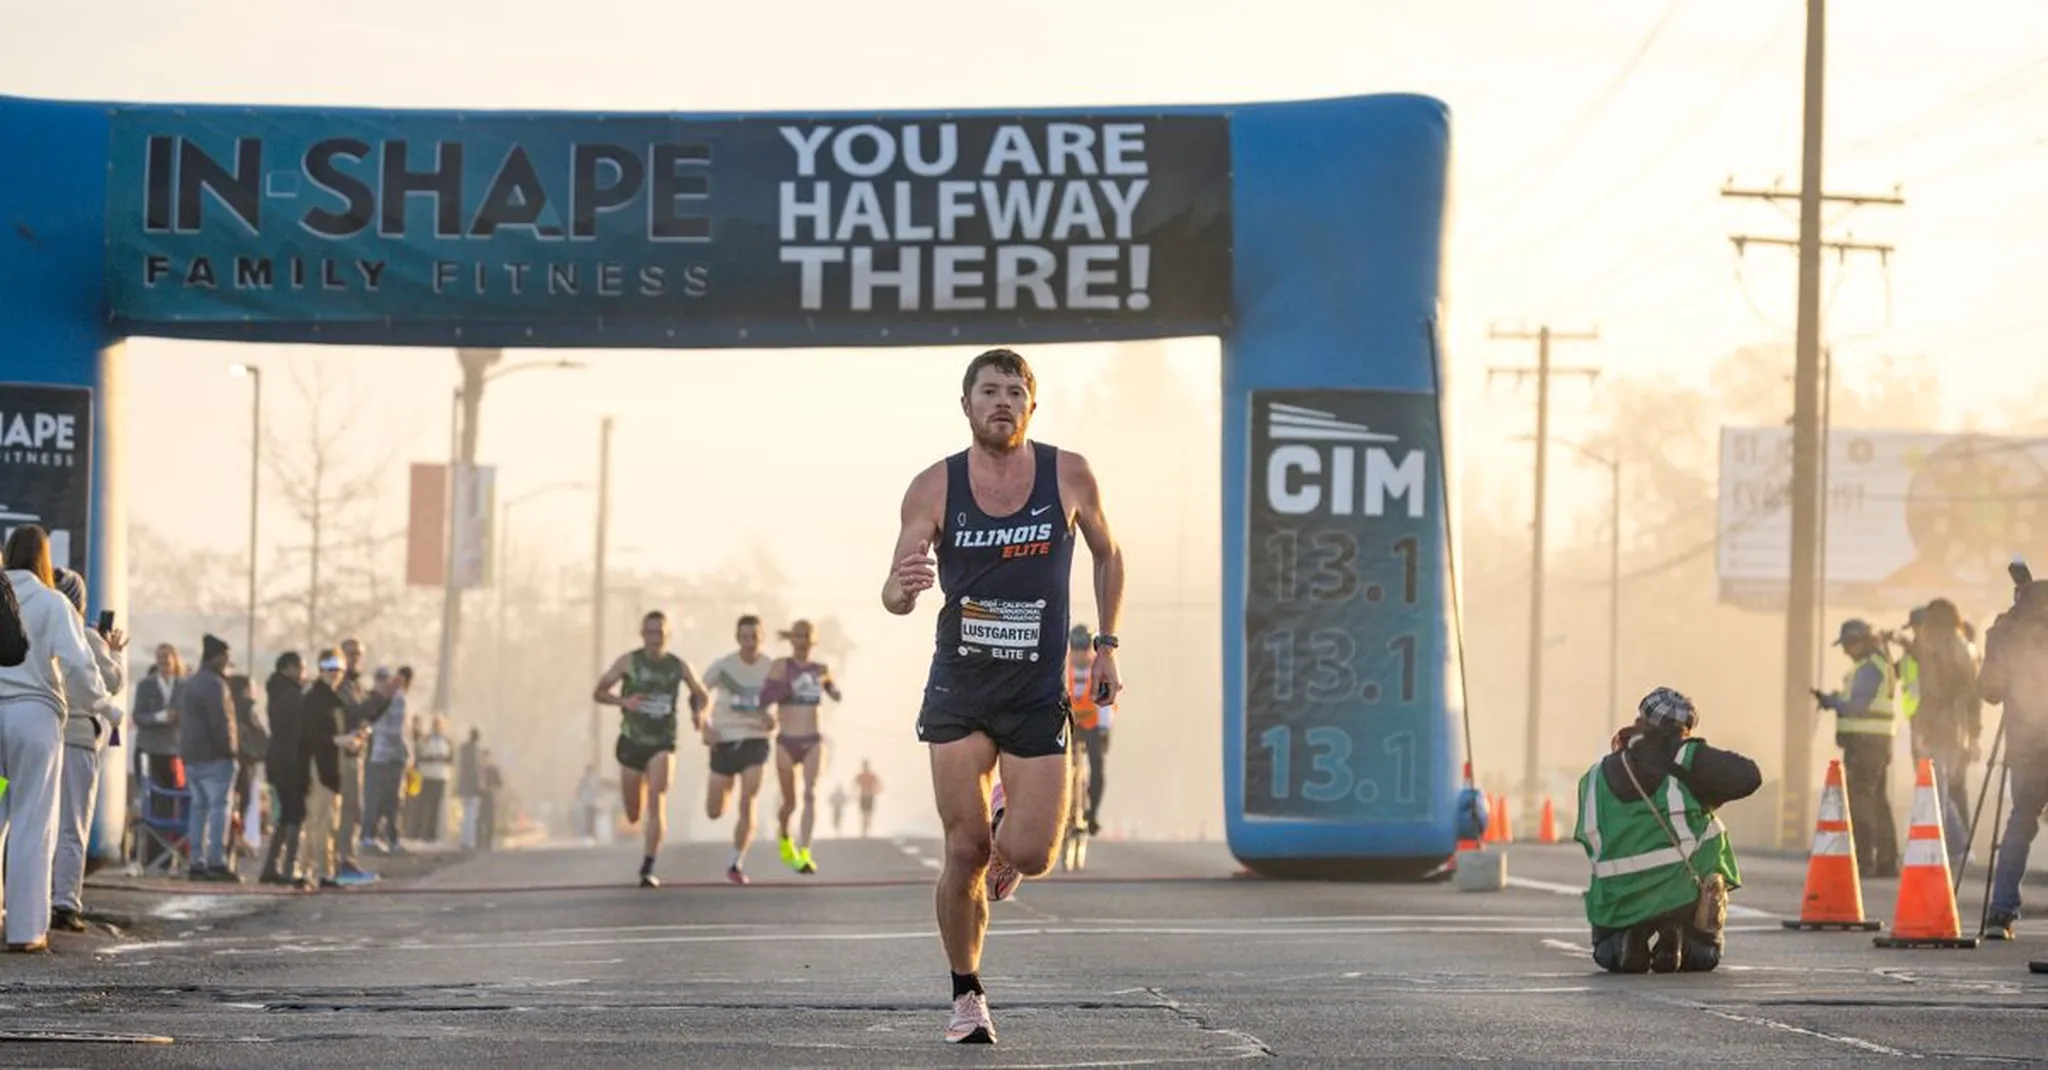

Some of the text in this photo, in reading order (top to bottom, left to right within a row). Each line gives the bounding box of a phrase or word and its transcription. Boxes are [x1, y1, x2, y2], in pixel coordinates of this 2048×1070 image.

[778, 123, 1149, 177] YOU ARE
[144, 135, 712, 242] IN-SHAPE
[779, 179, 1150, 241] HALFWAY
[143, 255, 710, 296] FAMILY FITNESS
[779, 244, 1151, 312] THERE!
[0, 411, 75, 450] APE
[1267, 444, 1425, 518] CIM
[954, 523, 1052, 547] ILLINOIS
[1002, 542, 1051, 558] ELITE
[1265, 529, 1420, 604] 13.1
[963, 624, 1038, 641] LUSTGARTEN
[992, 648, 1024, 660] ELITE
[1263, 627, 1420, 703] 13.1
[1260, 723, 1417, 803] 13.1
